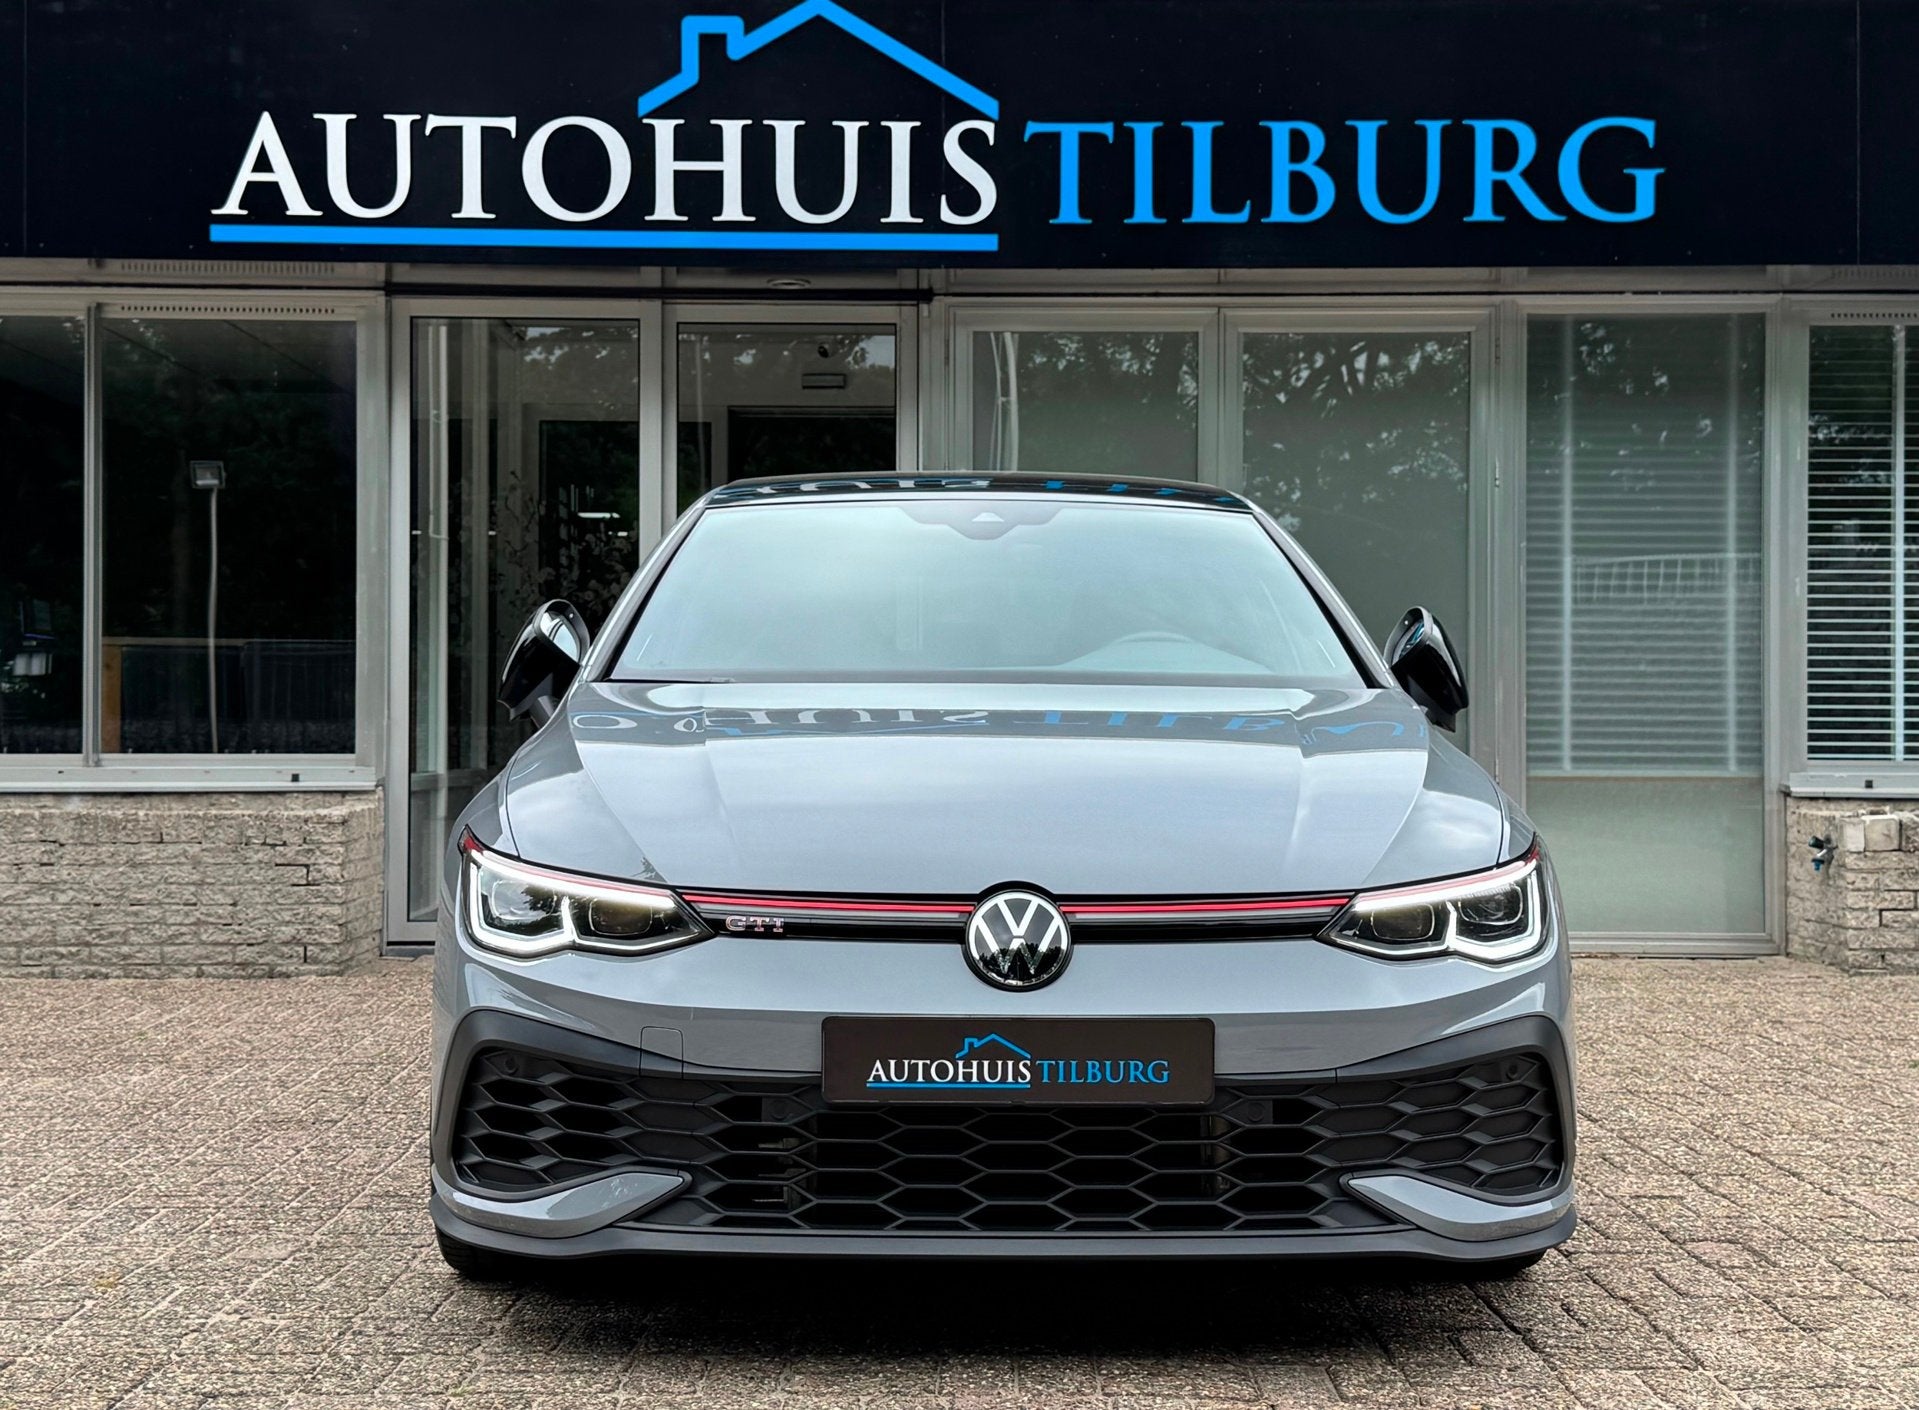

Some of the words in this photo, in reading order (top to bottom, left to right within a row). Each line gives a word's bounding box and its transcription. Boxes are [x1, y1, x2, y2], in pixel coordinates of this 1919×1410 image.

[210, 110, 998, 226] AUTOHUIS
[1023, 116, 1666, 225] TILBURG
[725, 914, 785, 933] GTI
[868, 1058, 1031, 1083] AUTOHUIS
[1036, 1060, 1170, 1083] TILBURG
